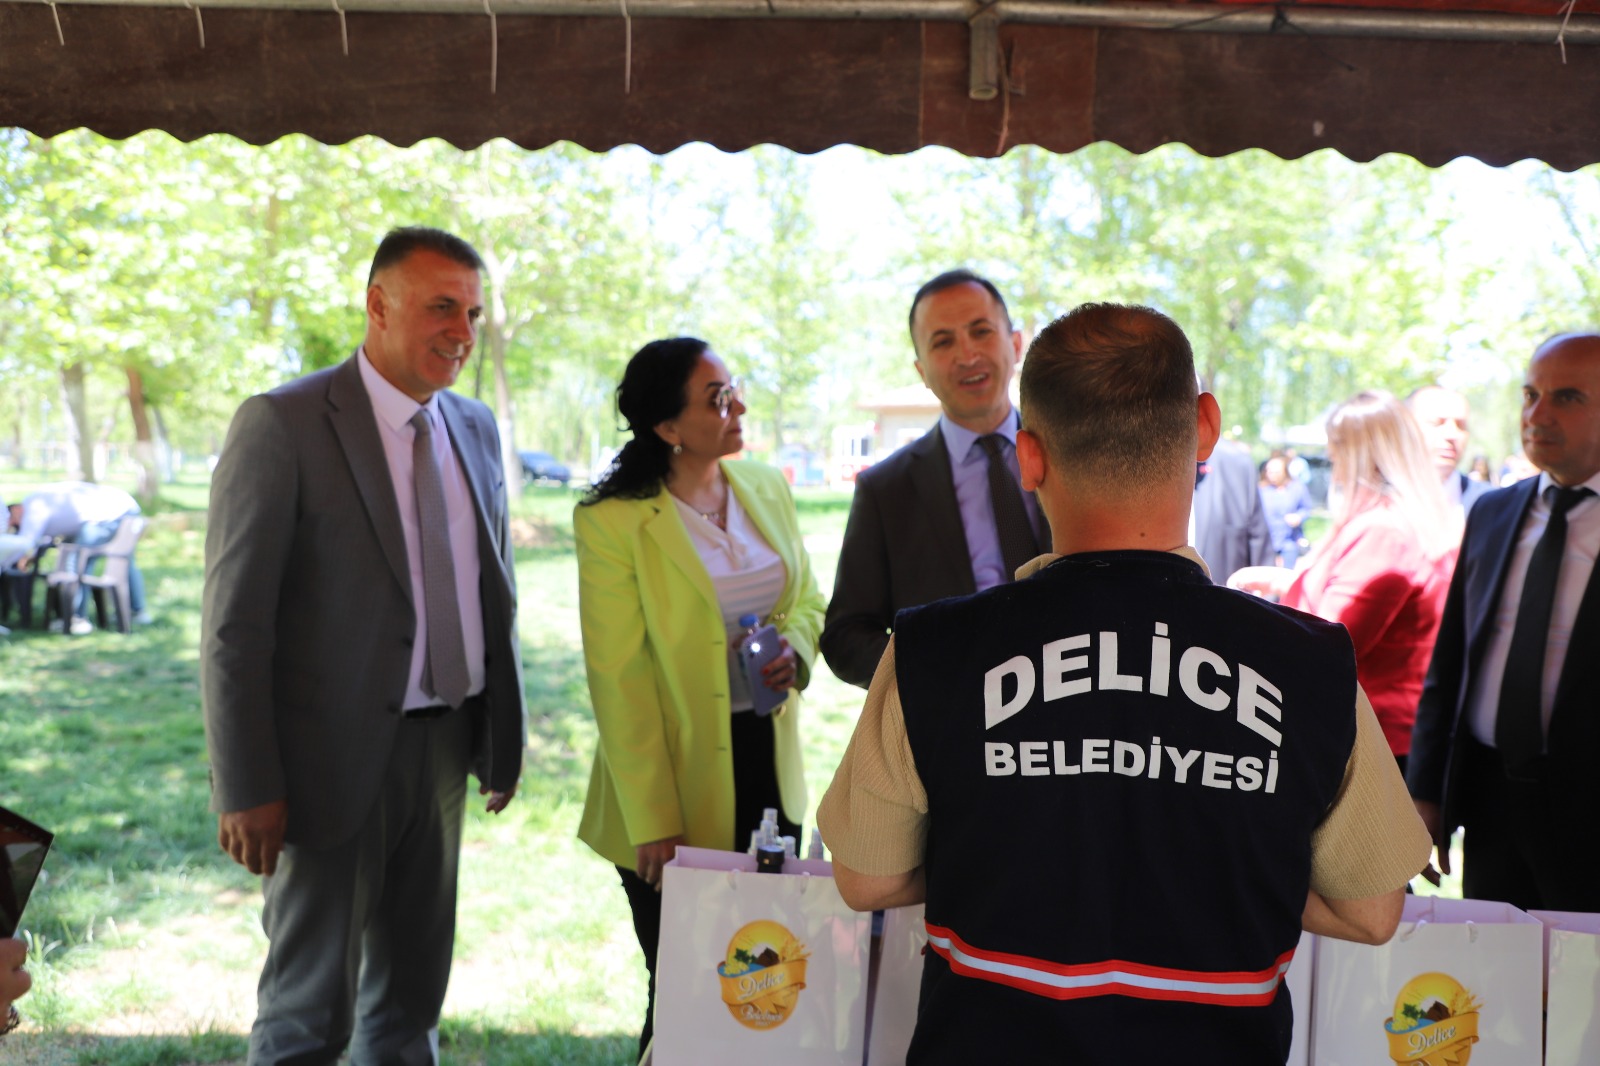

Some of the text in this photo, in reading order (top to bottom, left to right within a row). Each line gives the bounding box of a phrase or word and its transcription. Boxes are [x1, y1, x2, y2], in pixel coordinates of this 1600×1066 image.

[984, 621, 1282, 747] DELİCE
[984, 735, 1279, 793] BELEDİYESİ
[736, 972, 784, 1000] Delice
[1406, 1024, 1456, 1057] Delice
